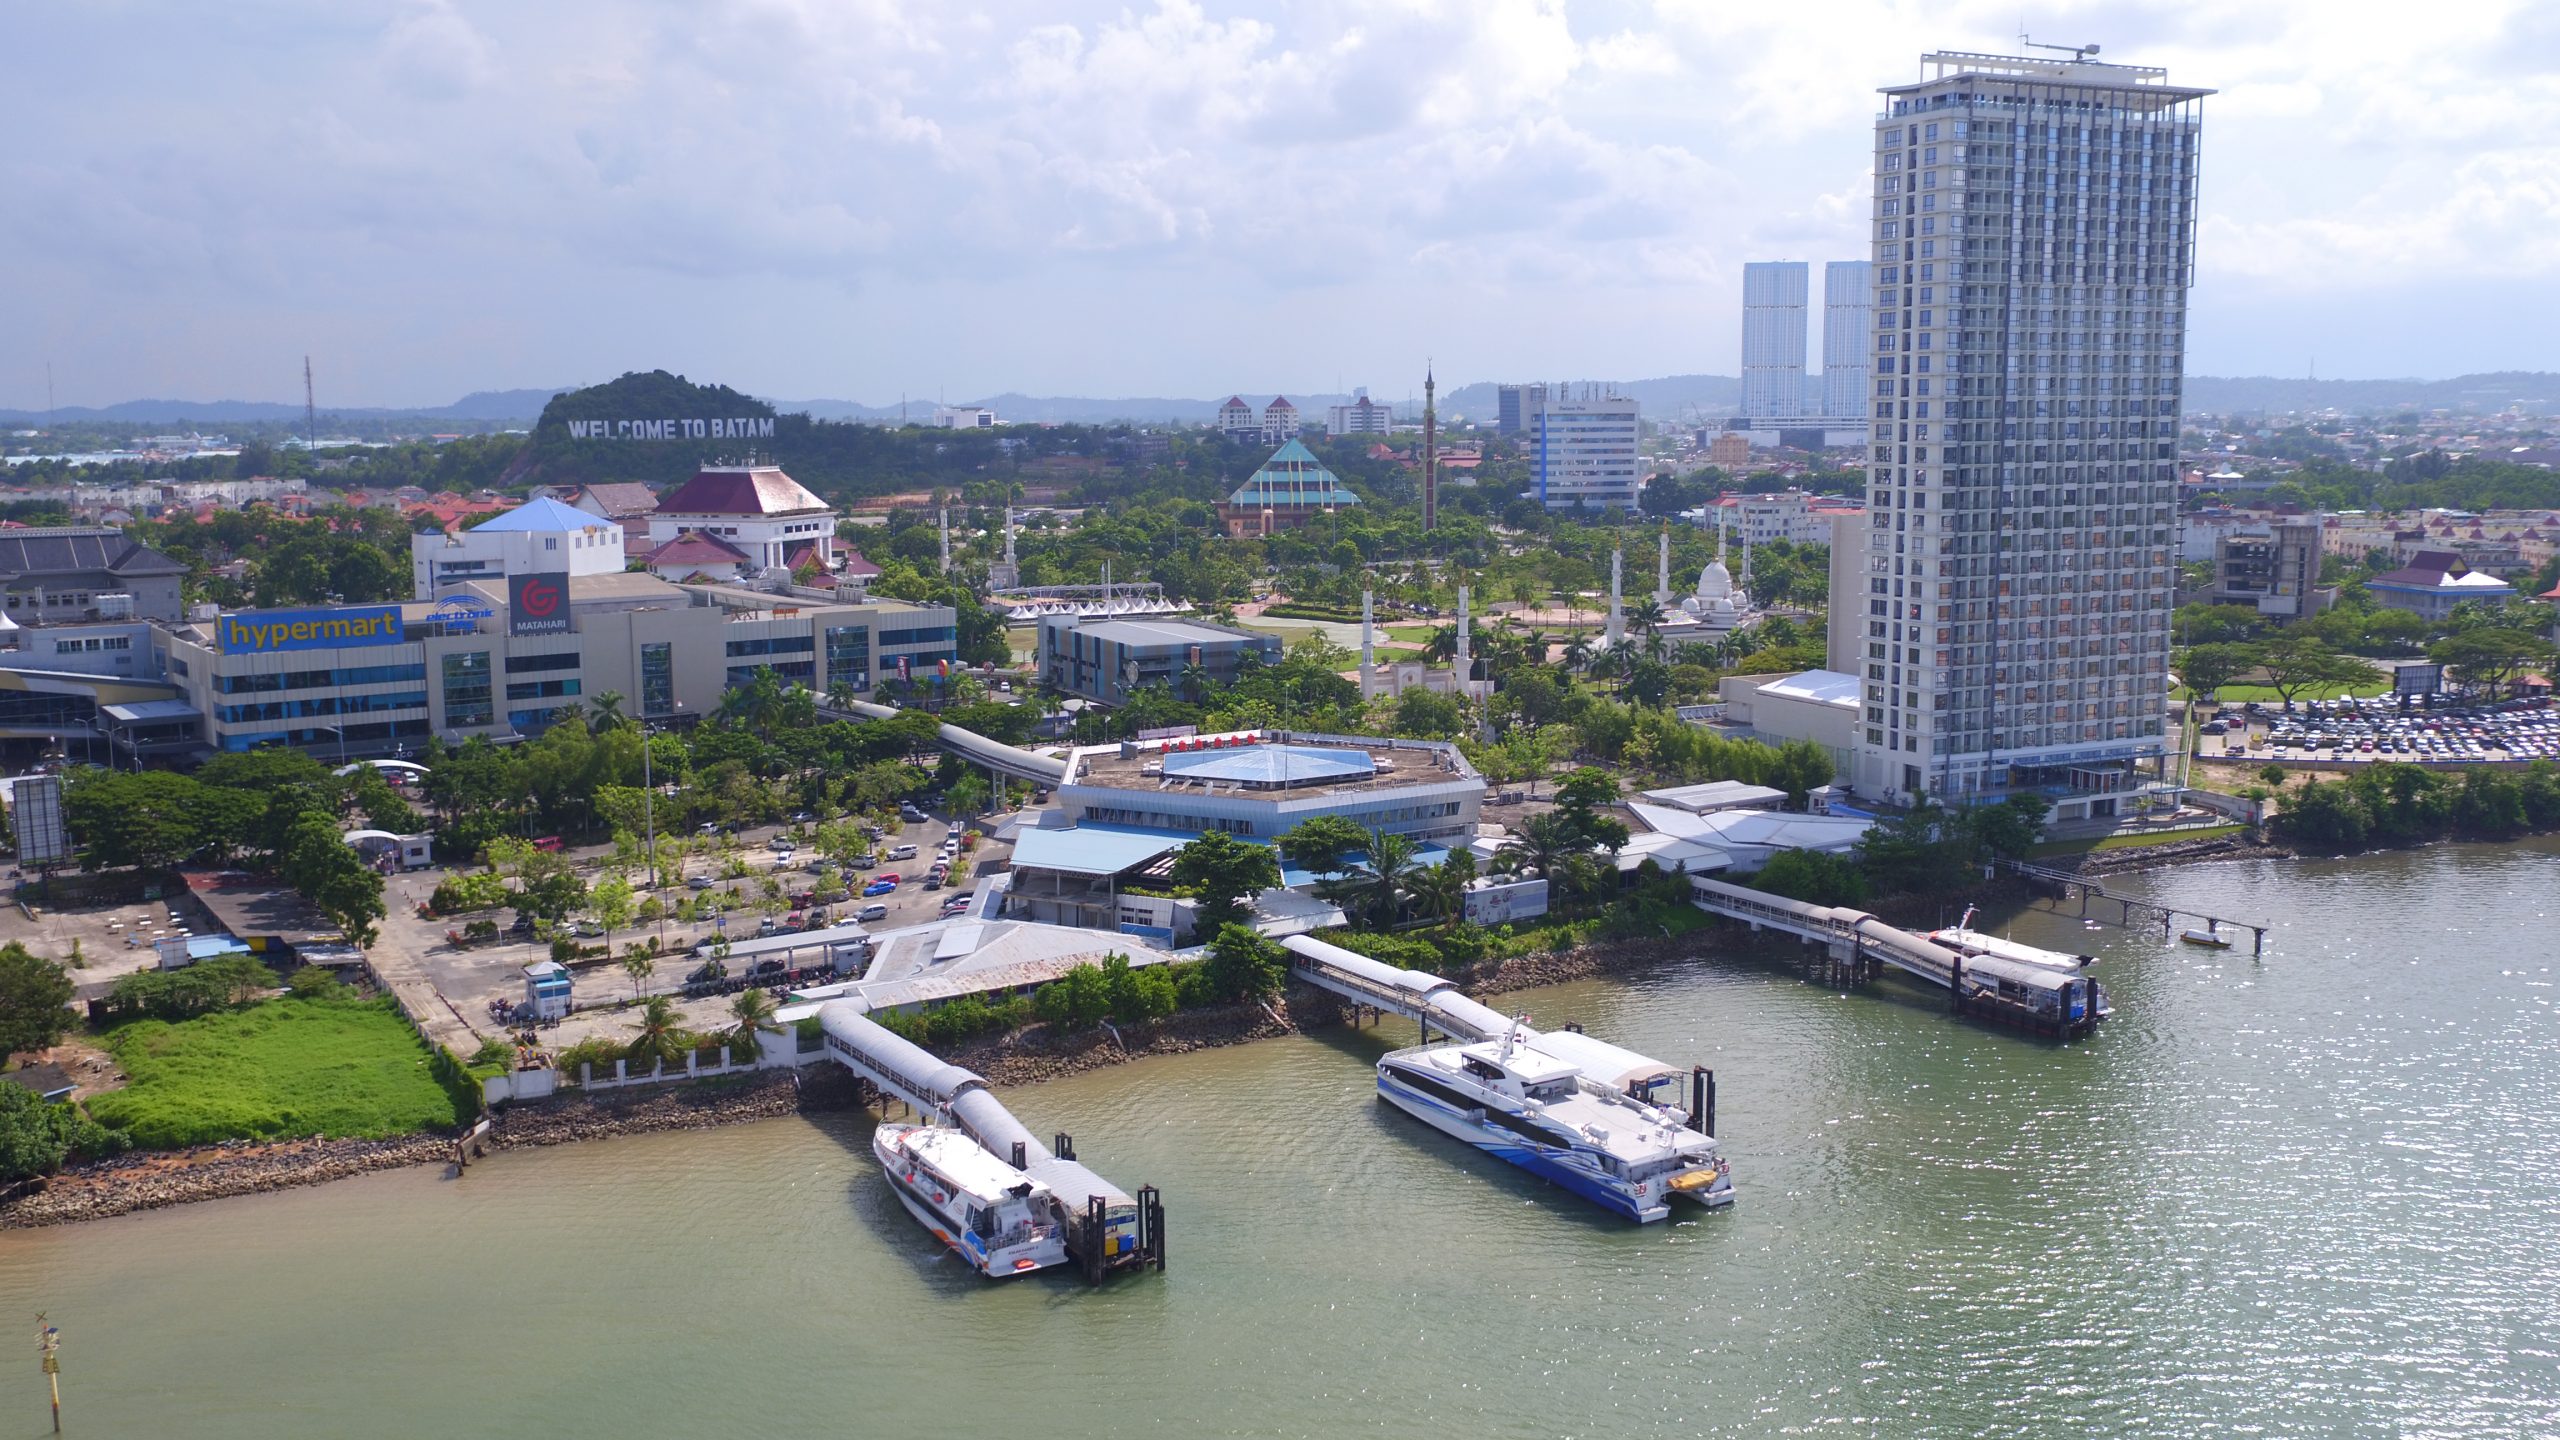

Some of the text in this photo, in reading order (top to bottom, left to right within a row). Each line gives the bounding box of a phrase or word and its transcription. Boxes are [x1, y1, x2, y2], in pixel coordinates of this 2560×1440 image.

[568, 418, 775, 440] WELCOME TO BATAM
[230, 612, 396, 648] hypermart
[517, 619, 566, 630] MATAHARI
